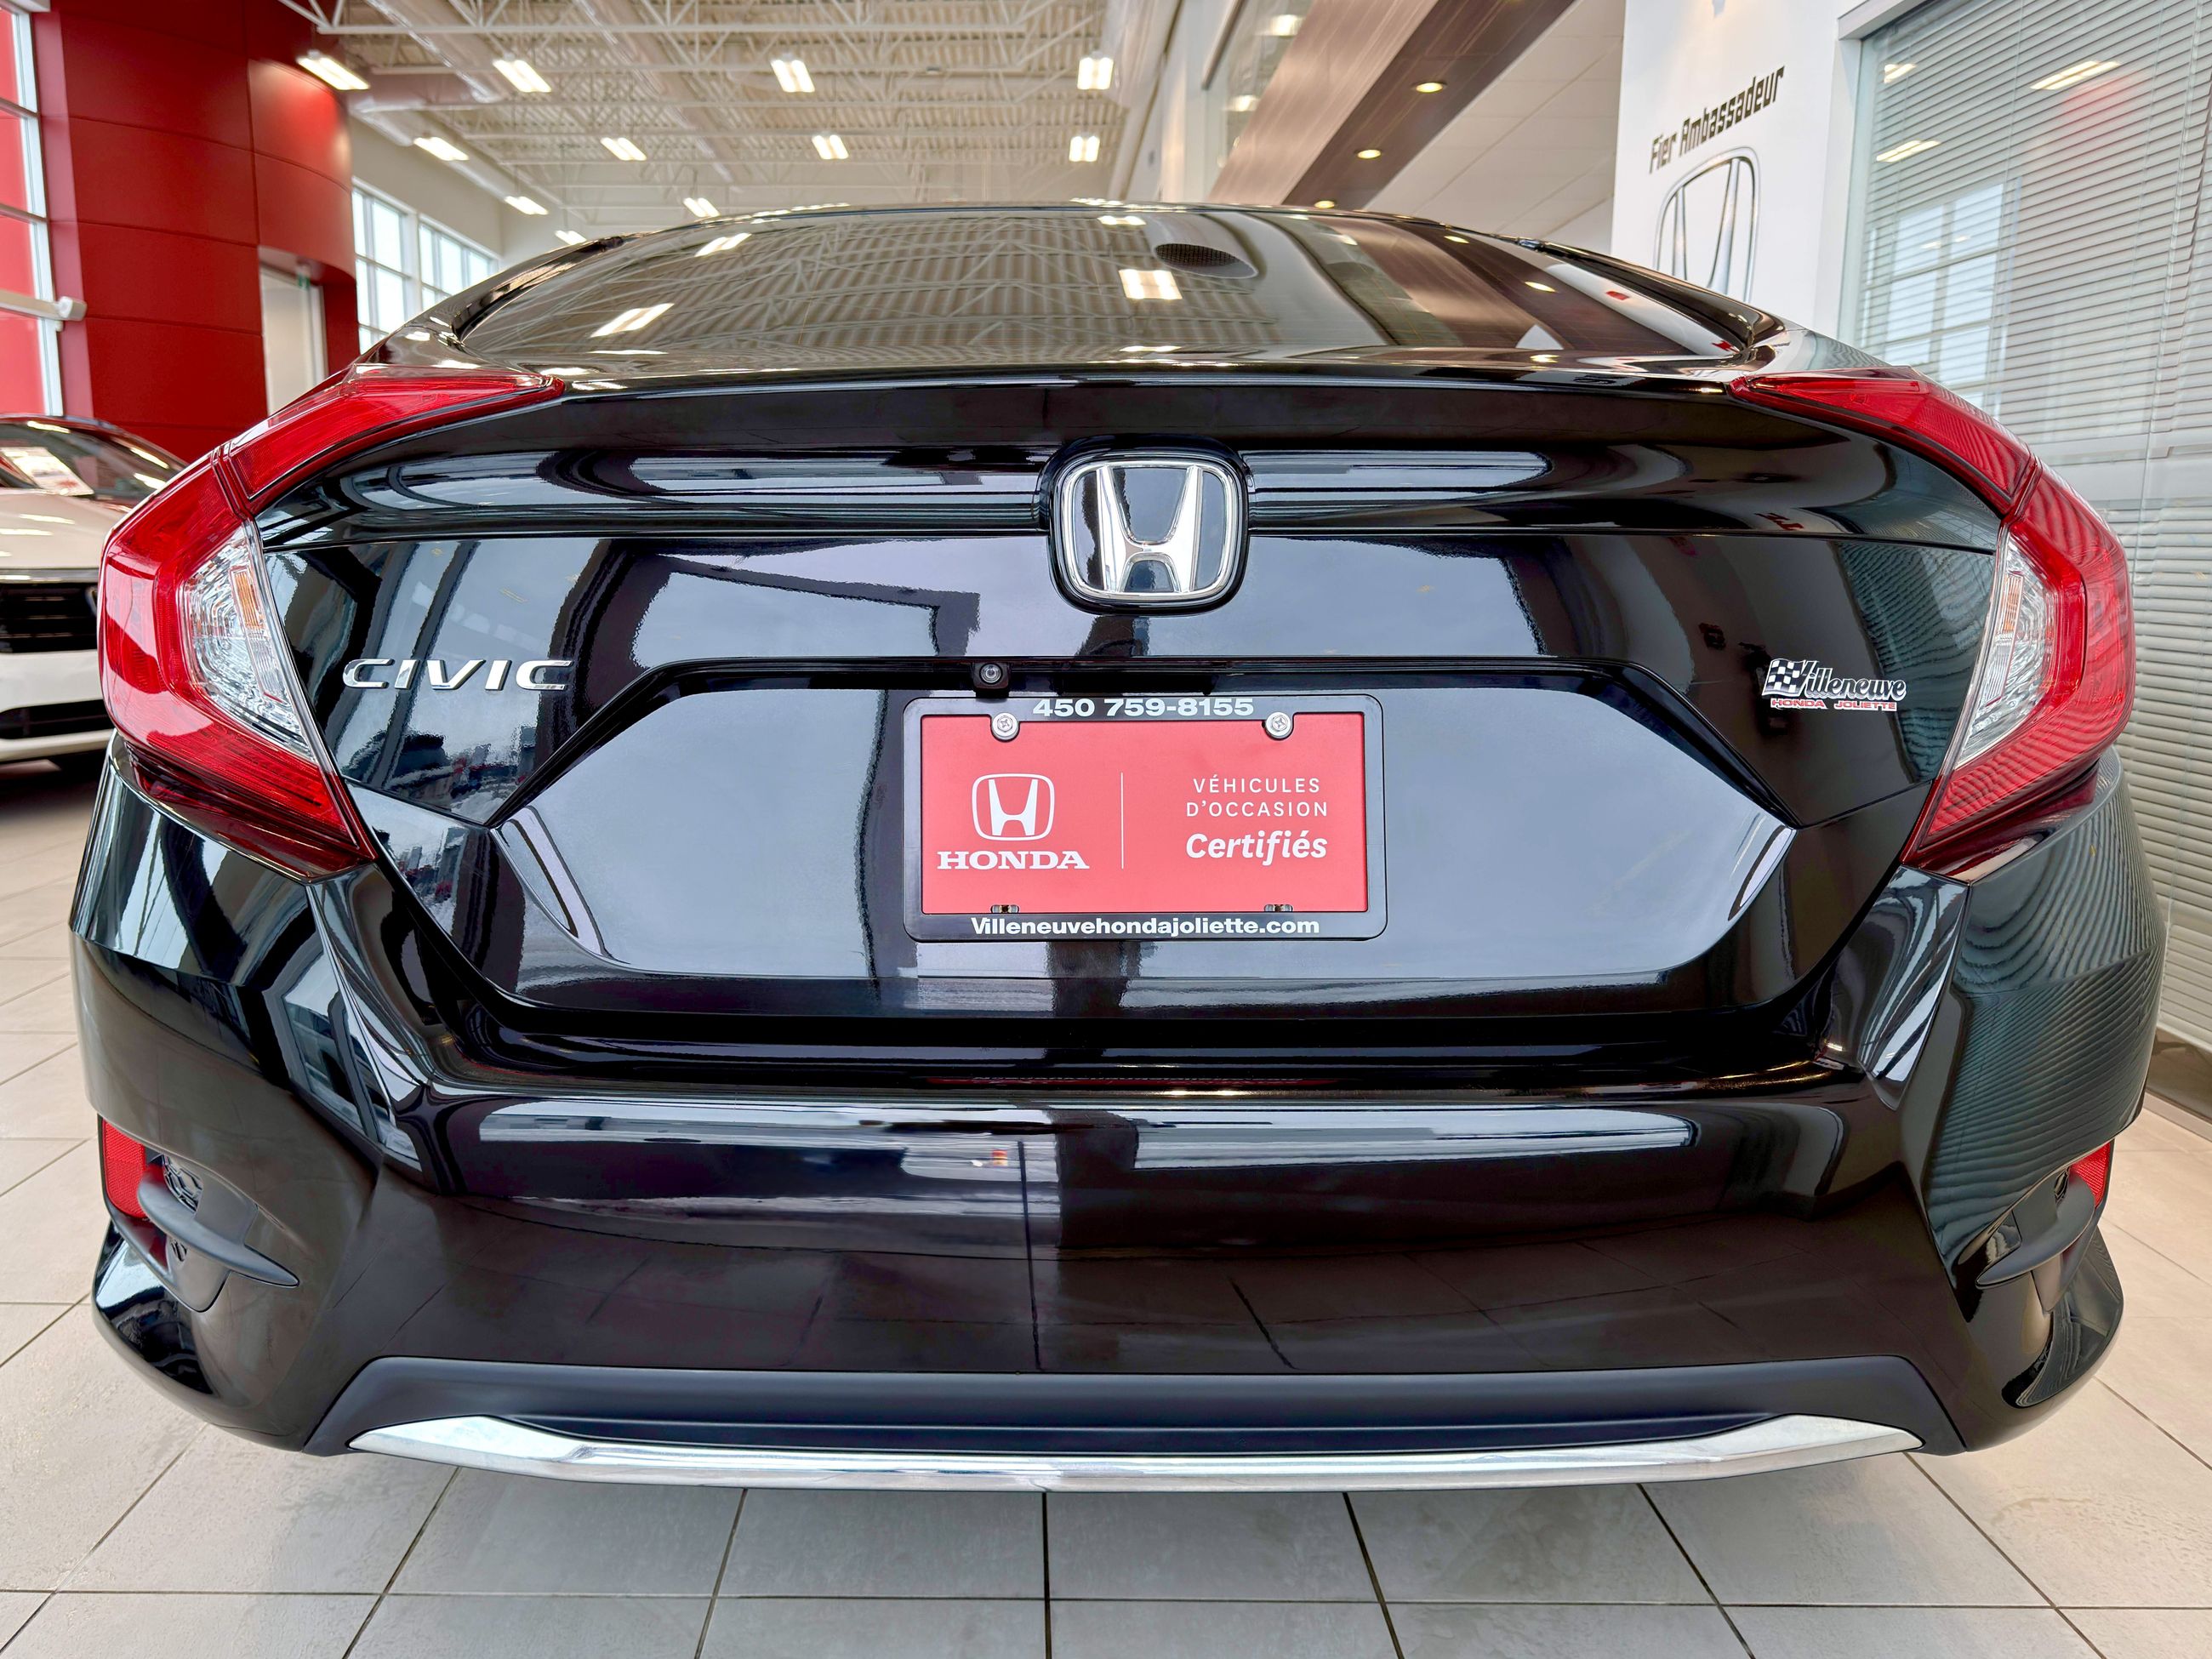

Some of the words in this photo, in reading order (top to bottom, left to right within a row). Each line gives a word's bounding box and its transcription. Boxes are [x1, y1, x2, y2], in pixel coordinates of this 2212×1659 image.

[1649, 132, 1678, 174] Fier
[1679, 65, 1786, 158] Ambassadeur
[342, 658, 573, 691] CIVIC
[1799, 660, 1907, 701] Villeneuve
[1032, 698, 1096, 717] 450
[1103, 698, 1255, 717] 759-8155
[1771, 698, 1827, 708] HONDA
[1834, 700, 1897, 710] JOLIETTE
[1193, 773, 1320, 794] VÉHICULES
[1186, 800, 1328, 818] D’OCCASION
[1185, 830, 1328, 866] Certifiés
[937, 850, 1090, 870] HONDA
[971, 917, 1320, 937] Villeneuvehondajoliette.com
